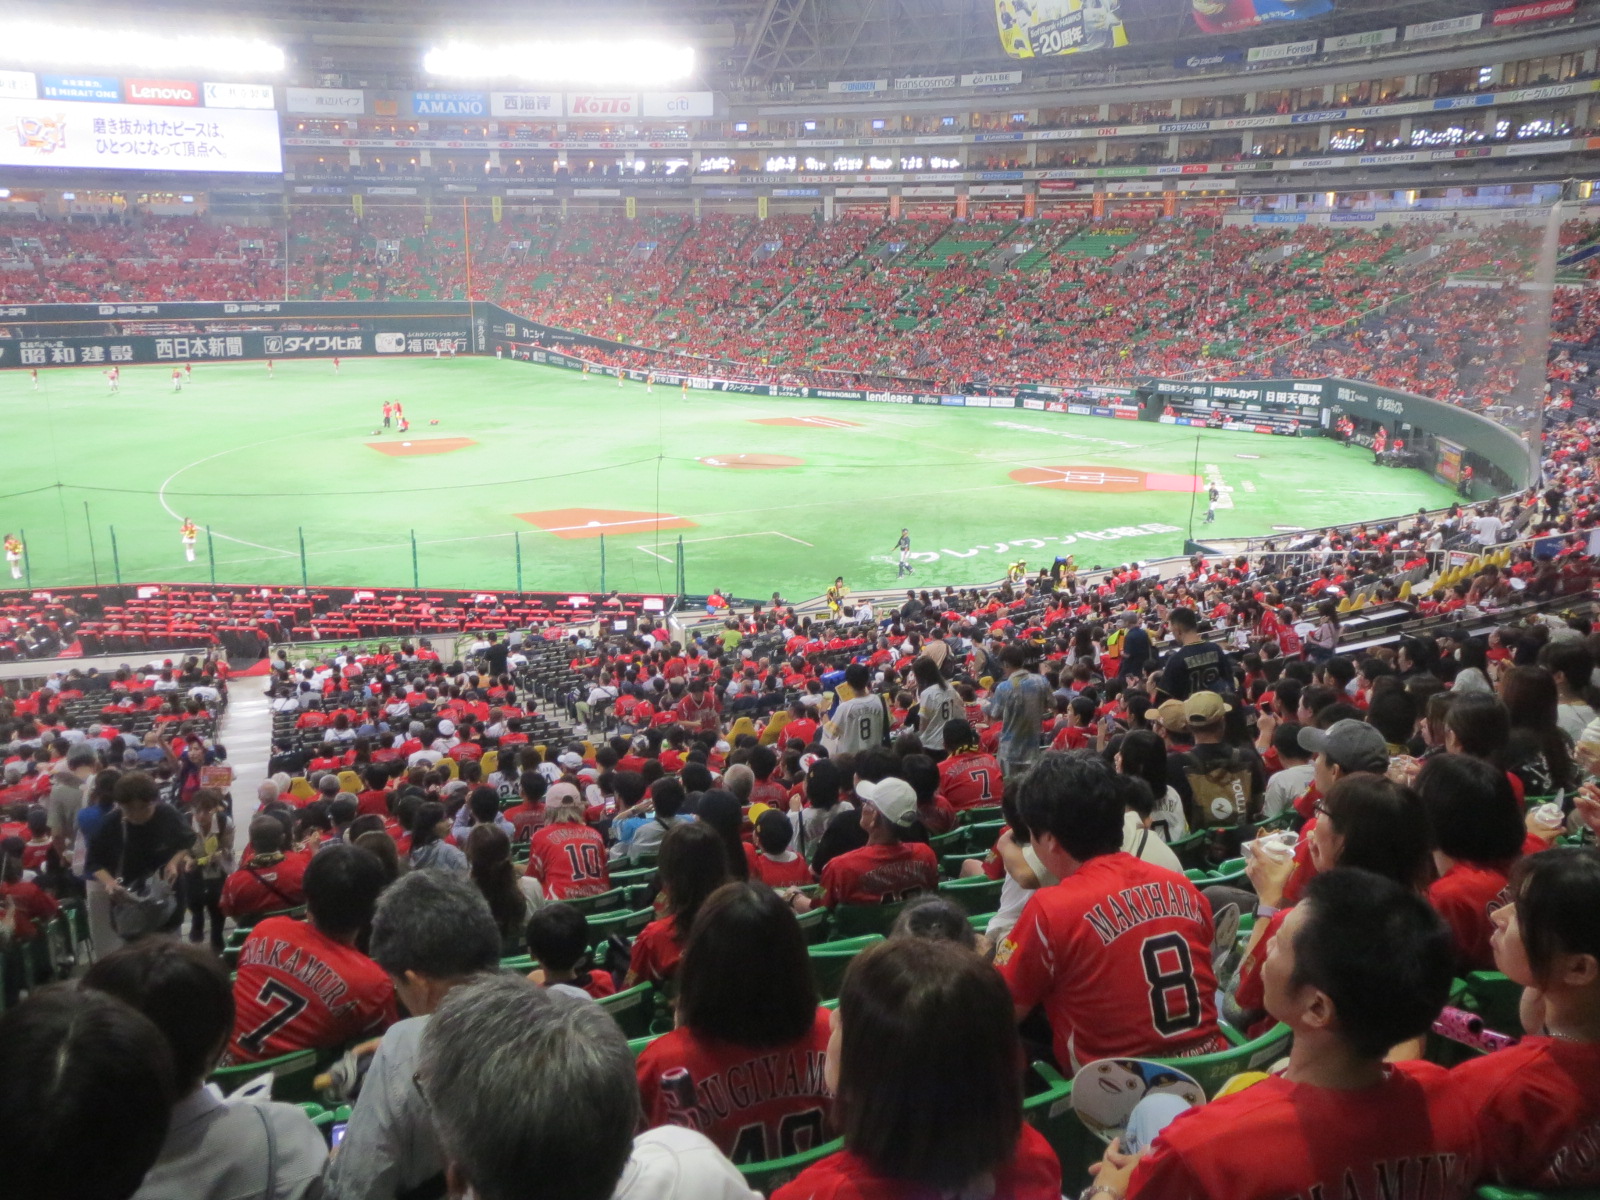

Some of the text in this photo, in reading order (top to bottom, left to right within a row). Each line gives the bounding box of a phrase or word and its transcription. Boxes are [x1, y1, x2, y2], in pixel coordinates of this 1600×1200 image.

[1041, 26, 1083, 55] 20周年
[1287, 43, 1314, 55] Forest
[131, 83, 192, 100] Lenovo
[895, 78, 955, 89] transcosmos
[59, 88, 118, 99] MIRAIT ONE
[418, 101, 483, 114] AMANO
[667, 96, 689, 111] citi
[1361, 107, 1382, 116] NEC
[93, 118, 225, 139] 磨き抜かれたピースは、
[1098, 127, 1119, 136] OKI
[96, 138, 228, 158] ひとつになって頂点へ。
[155, 337, 243, 359] 西日本新聞
[284, 336, 362, 351] ダイワ化成
[407, 338, 467, 352] 福岡銀行
[20, 345, 133, 364] 昭和建設
[866, 391, 914, 403] lendlease
[1157, 383, 1207, 395] 西日本シティ銀行
[1213, 387, 1259, 399] ヨドバシカメラ
[918, 395, 938, 404] FUJITSU
[1266, 391, 1321, 406] 日田天領水
[941, 698, 954, 720] 61
[859, 717, 871, 741] 8
[969, 769, 993, 800] 7
[564, 843, 602, 881] 10
[1084, 880, 1207, 945] MAKIHARA
[240, 936, 360, 1017] NAKAMURA
[1140, 930, 1202, 1039] 8
[236, 976, 310, 1053] 7
